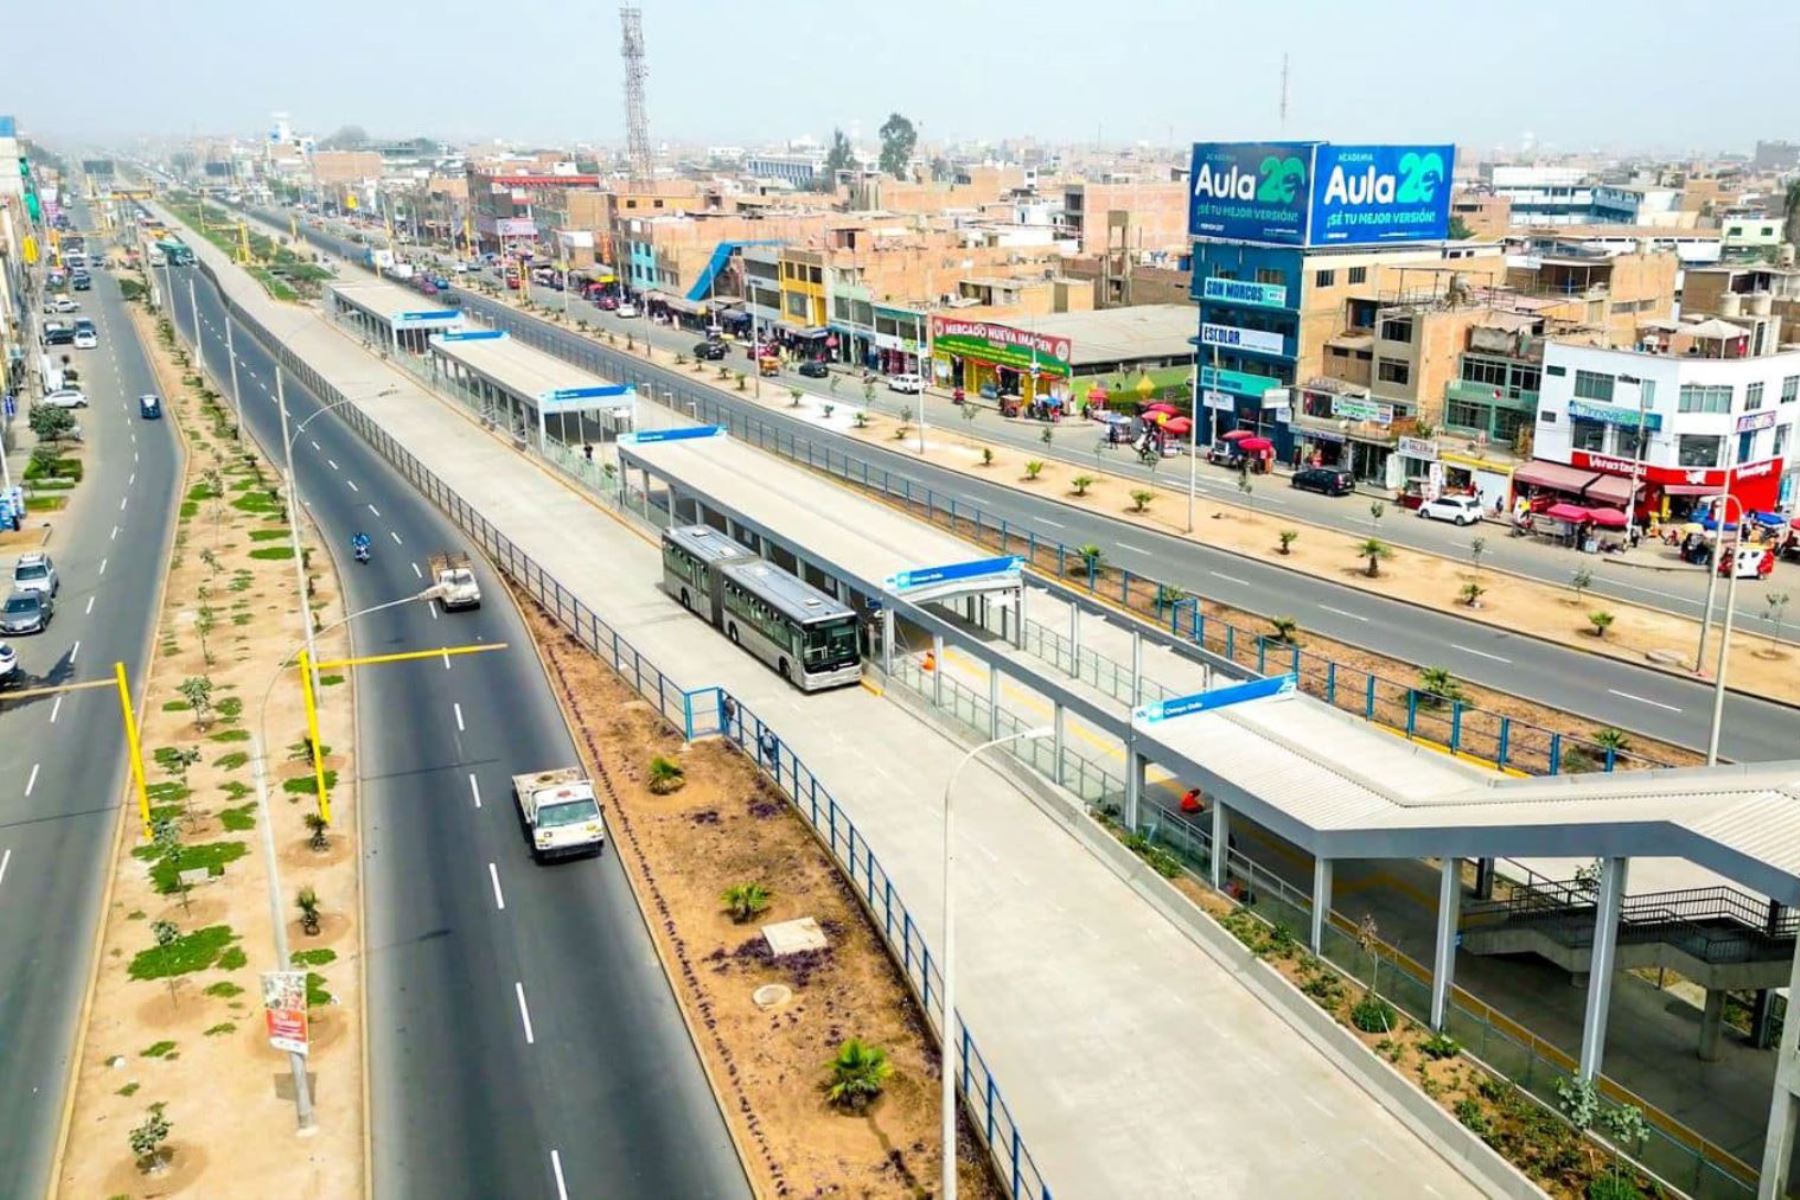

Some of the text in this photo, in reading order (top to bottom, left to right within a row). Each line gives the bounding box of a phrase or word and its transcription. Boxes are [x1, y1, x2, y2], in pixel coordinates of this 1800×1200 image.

[1338, 153, 1373, 162] ACADEMIA
[1194, 163, 1256, 201] Aula
[1324, 164, 1396, 205] Aula
[1211, 205, 1223, 216] TU
[1223, 206, 1254, 219] MEJOR
[1254, 208, 1299, 222] VERSIÓN!
[1344, 213, 1357, 225] TU
[1358, 212, 1391, 225] MEJOR
[1393, 210, 1436, 224] VERSIÓN!
[1206, 280, 1225, 298] SAN
[1226, 282, 1263, 302] MARCOS
[945, 324, 986, 337] MERCADO
[988, 327, 1017, 344] NUEVA
[1204, 326, 1240, 345] ESCOLAR
